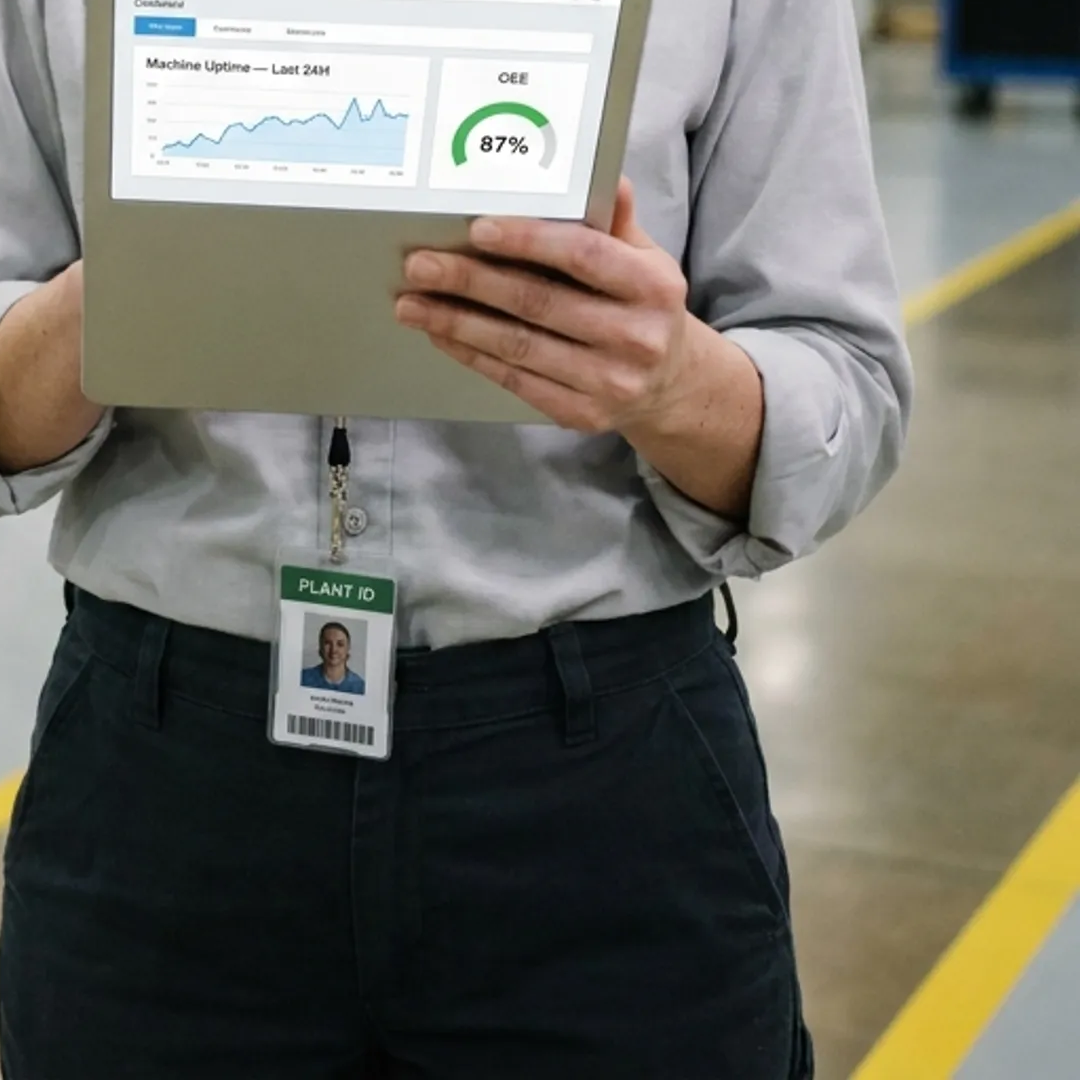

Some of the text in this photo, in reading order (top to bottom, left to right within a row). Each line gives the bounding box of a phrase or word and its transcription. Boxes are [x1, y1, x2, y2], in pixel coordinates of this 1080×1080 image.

[146, 57, 202, 71] Machine
[205, 59, 251, 75] Uptime
[272, 63, 300, 75] Last
[303, 64, 331, 77] 24H
[497, 71, 529, 86] OEE
[480, 135, 529, 155] 87%
[298, 577, 354, 599] PLANT
